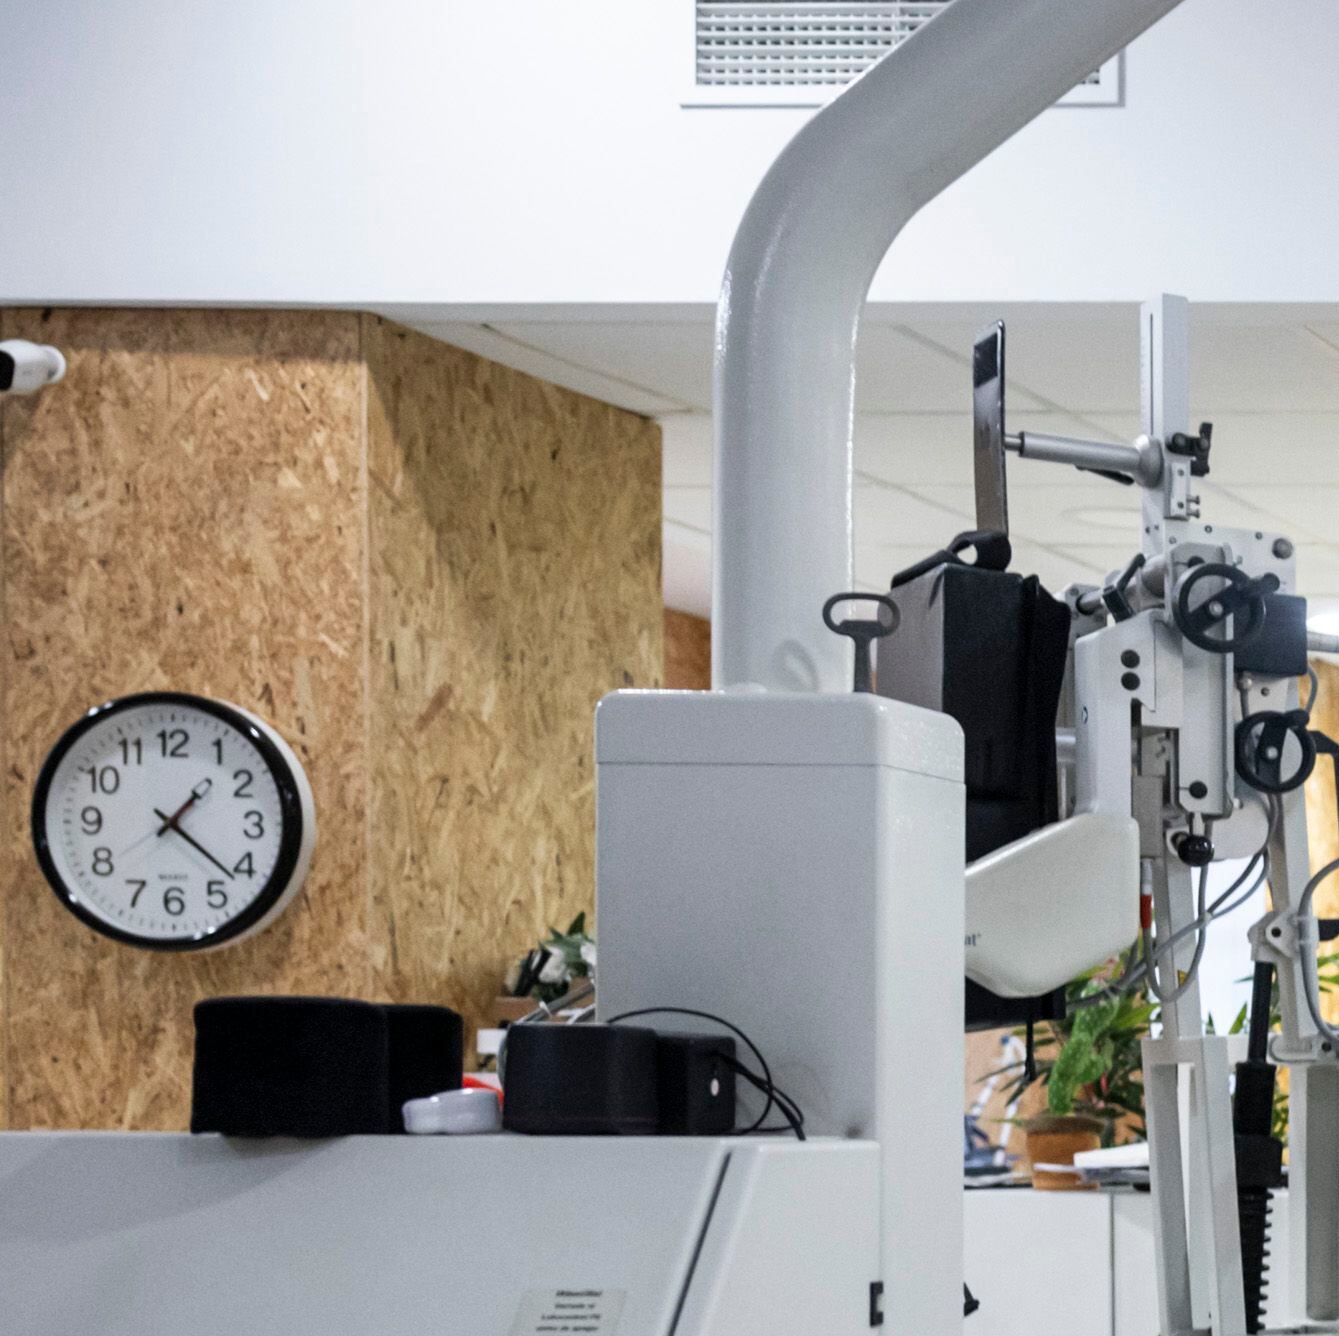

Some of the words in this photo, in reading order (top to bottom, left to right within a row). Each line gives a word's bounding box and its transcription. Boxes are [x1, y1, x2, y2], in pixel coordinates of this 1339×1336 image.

[119, 739, 143, 765] 11
[157, 729, 189, 758] 12
[212, 739, 223, 765] 1
[88, 766, 120, 795] 10
[233, 770, 253, 798] 2
[81, 806, 103, 835] 9
[243, 811, 265, 840] 3
[92, 847, 114, 877] 8
[233, 852, 255, 878] 4
[125, 879, 147, 908] 7
[163, 887, 185, 916] 6
[207, 880, 228, 908] 5
